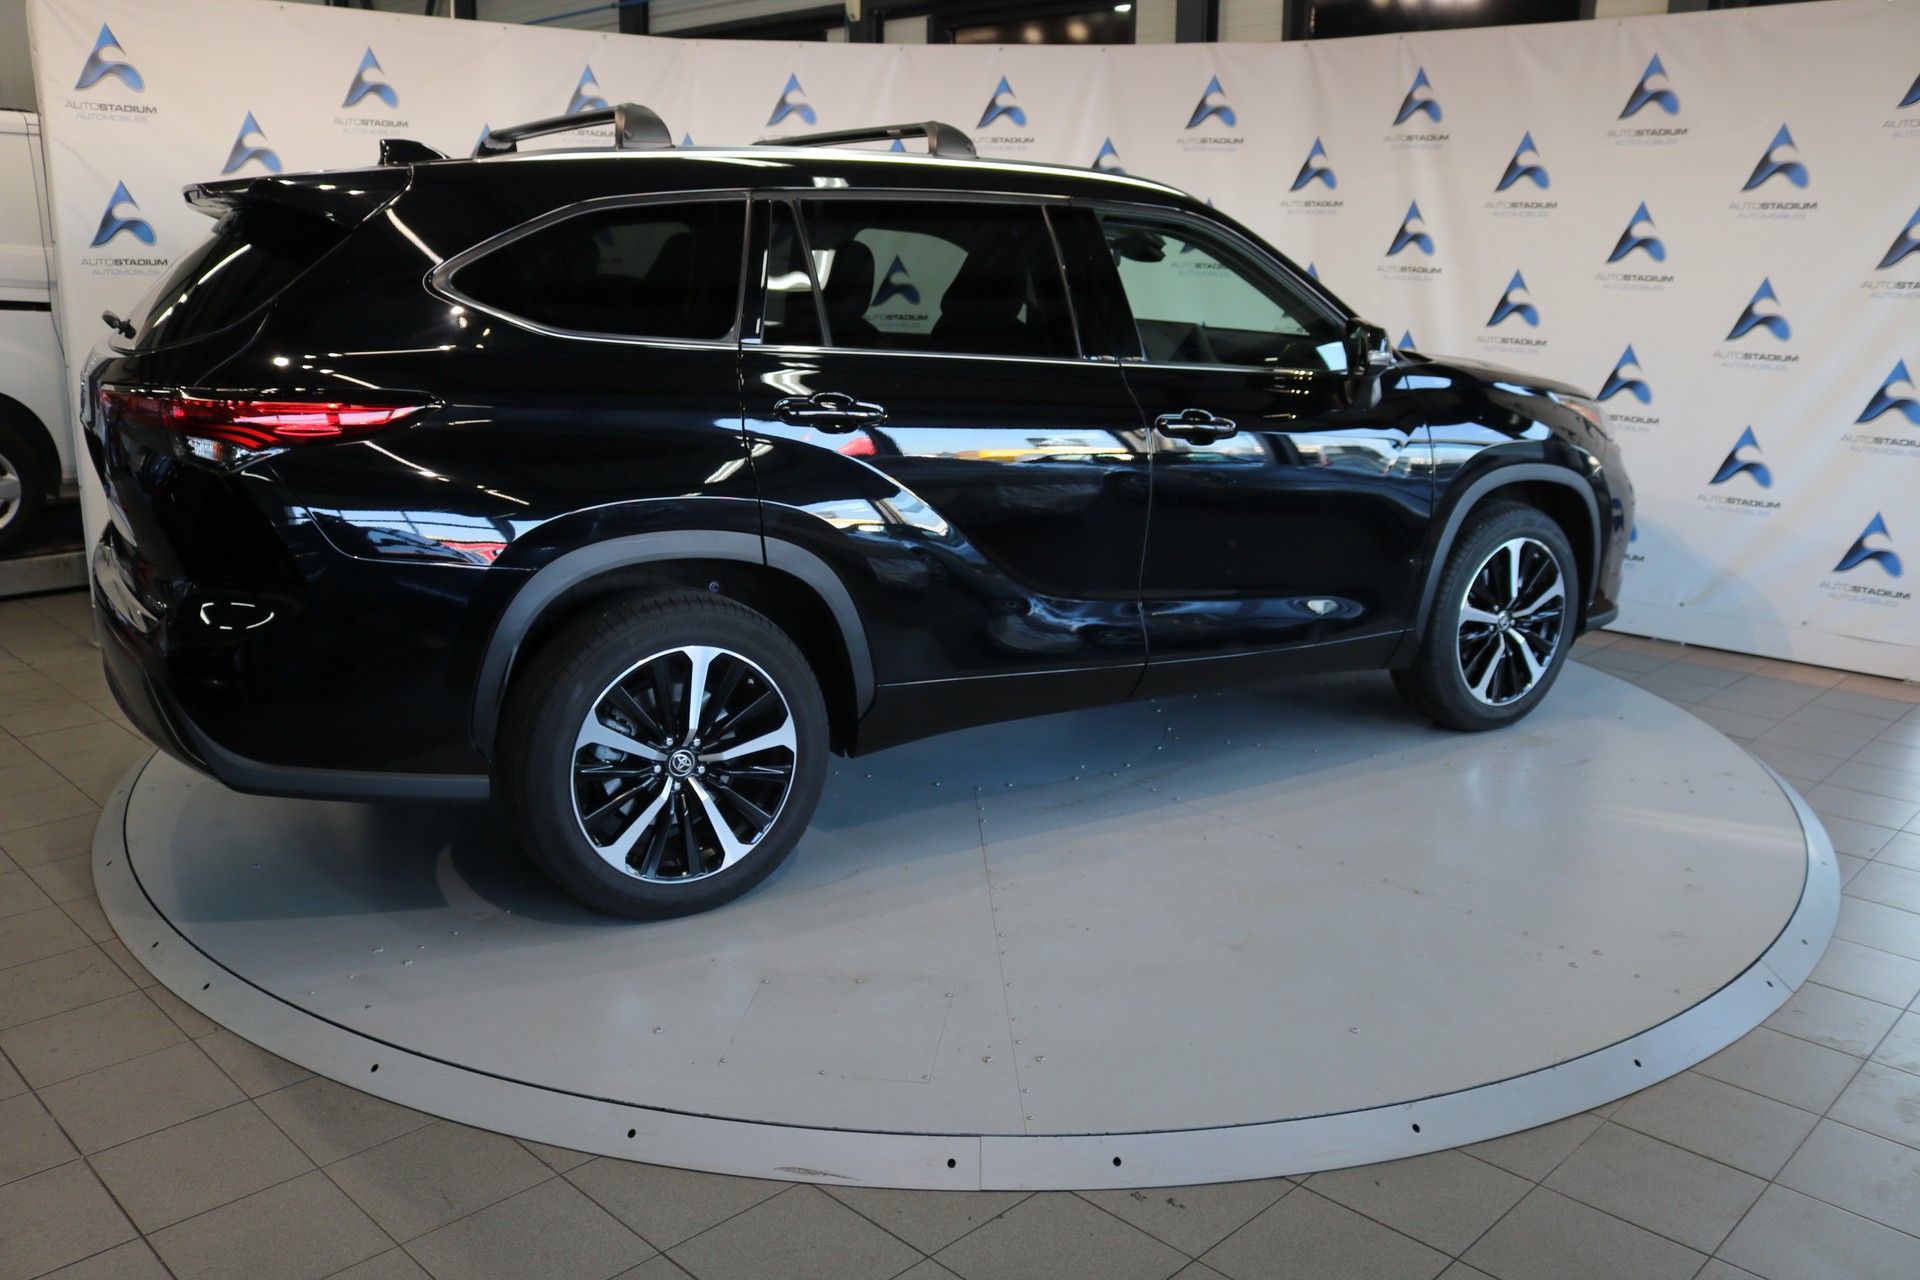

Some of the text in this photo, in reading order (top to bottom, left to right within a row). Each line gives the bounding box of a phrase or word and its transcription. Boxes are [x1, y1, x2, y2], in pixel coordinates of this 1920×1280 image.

[65, 100, 157, 114] AUTOSTADIUM
[76, 112, 148, 124] AUTOMOBILES
[332, 117, 409, 128] AUTOSTADIUM
[1383, 134, 1450, 142] AUTOSTADIUM
[1607, 127, 1689, 138] AUTOSTADIUM
[1176, 137, 1245, 145] AUTOSTADIUM
[1280, 200, 1345, 208] AUTOSTADIUM
[1484, 201, 1559, 210] AUTOSTADIUM
[1728, 201, 1819, 211] AUTOSTADIUM
[80, 258, 169, 267] AUTOSTADIUM
[91, 267, 160, 277] AUTOMOBILES
[1376, 264, 1443, 274] AUTOSTADIUM
[1594, 272, 1675, 283] AUTOSTADIUM
[1476, 335, 1548, 347] AUTOSTADIUM
[1712, 351, 1799, 363] AUTOSTADIUM
[1609, 414, 1660, 425] STADIUM
[1696, 494, 1782, 510] AUTOSTADIUM
[1818, 581, 1911, 601] AUTOSTADIUM
